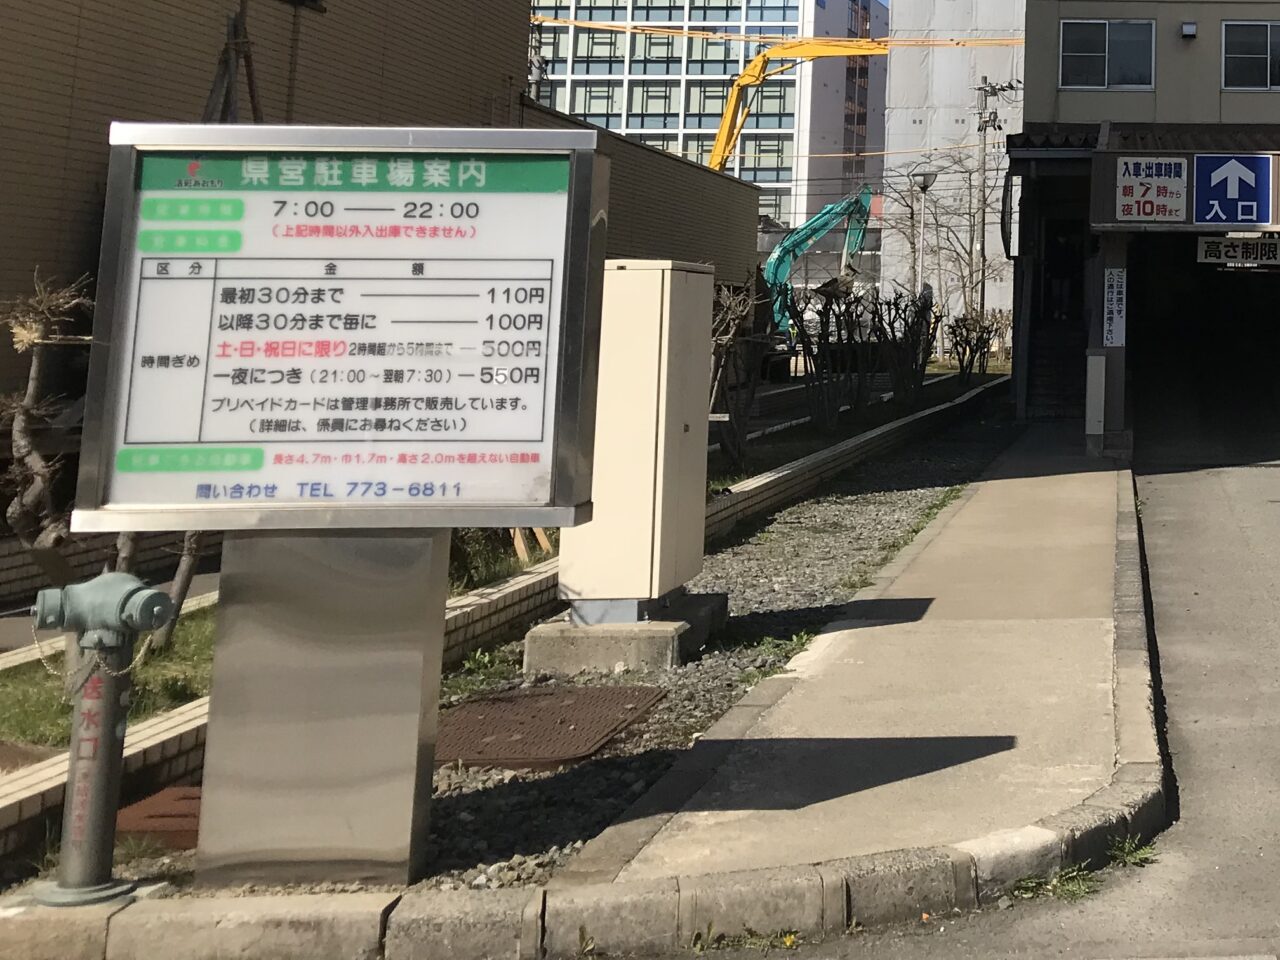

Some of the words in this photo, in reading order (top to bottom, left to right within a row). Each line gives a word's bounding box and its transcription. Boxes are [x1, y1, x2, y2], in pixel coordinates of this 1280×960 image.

[240, 157, 487, 187] 県営駐車場案内
[1122, 161, 1183, 179] 入車・出車時間
[272, 200, 335, 218] 7:00
[403, 201, 480, 219] 22:00
[1121, 200, 1180, 217] 夜10時まで
[1205, 200, 1258, 221] 入口
[271, 224, 478, 239] （上記時間以外入出庫できません）
[220, 286, 344, 305] 最初30分まで
[487, 287, 545, 304] 110円
[217, 313, 377, 331] 以降30分まで毎に
[486, 313, 543, 331] 100円
[481, 340, 541, 357] 500円
[141, 354, 200, 369] 時間ぎめ
[213, 367, 303, 385] 一夜につき
[480, 366, 540, 384] 550円
[195, 483, 278, 499] 問い合わせ
[296, 482, 334, 497] TEL
[346, 481, 461, 497] 773-6811
[77, 675, 104, 760] 送水口
